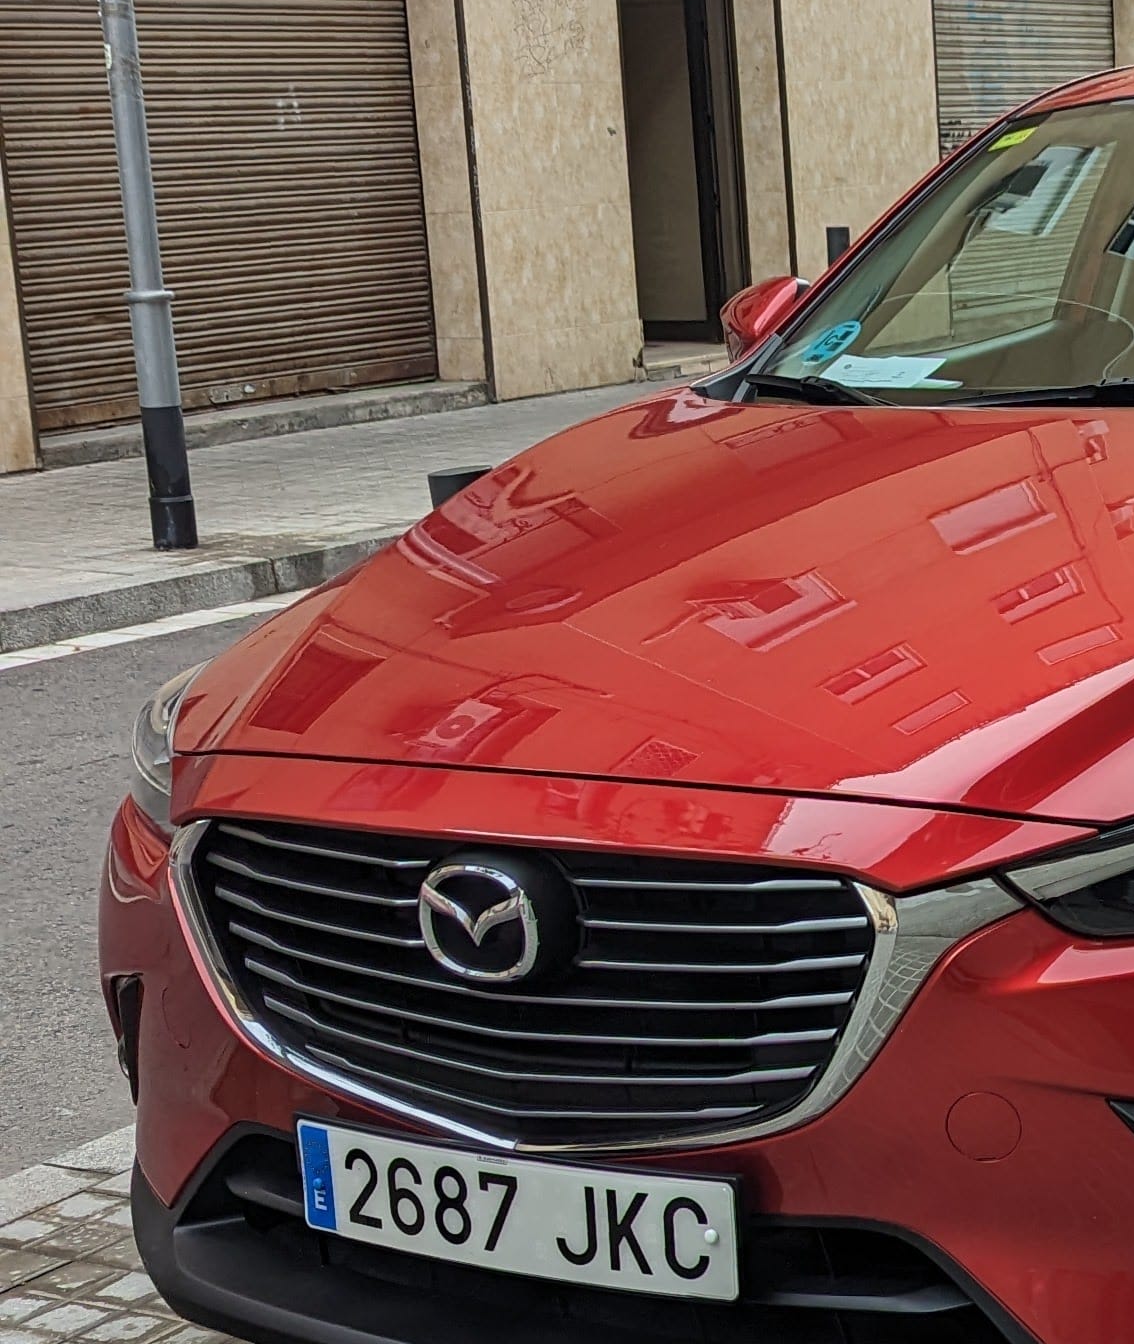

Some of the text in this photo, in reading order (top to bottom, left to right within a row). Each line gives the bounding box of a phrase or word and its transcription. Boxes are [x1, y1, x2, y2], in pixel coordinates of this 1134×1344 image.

[314, 1188, 328, 1211] E
[344, 1148, 711, 1280] 2687 JKC
